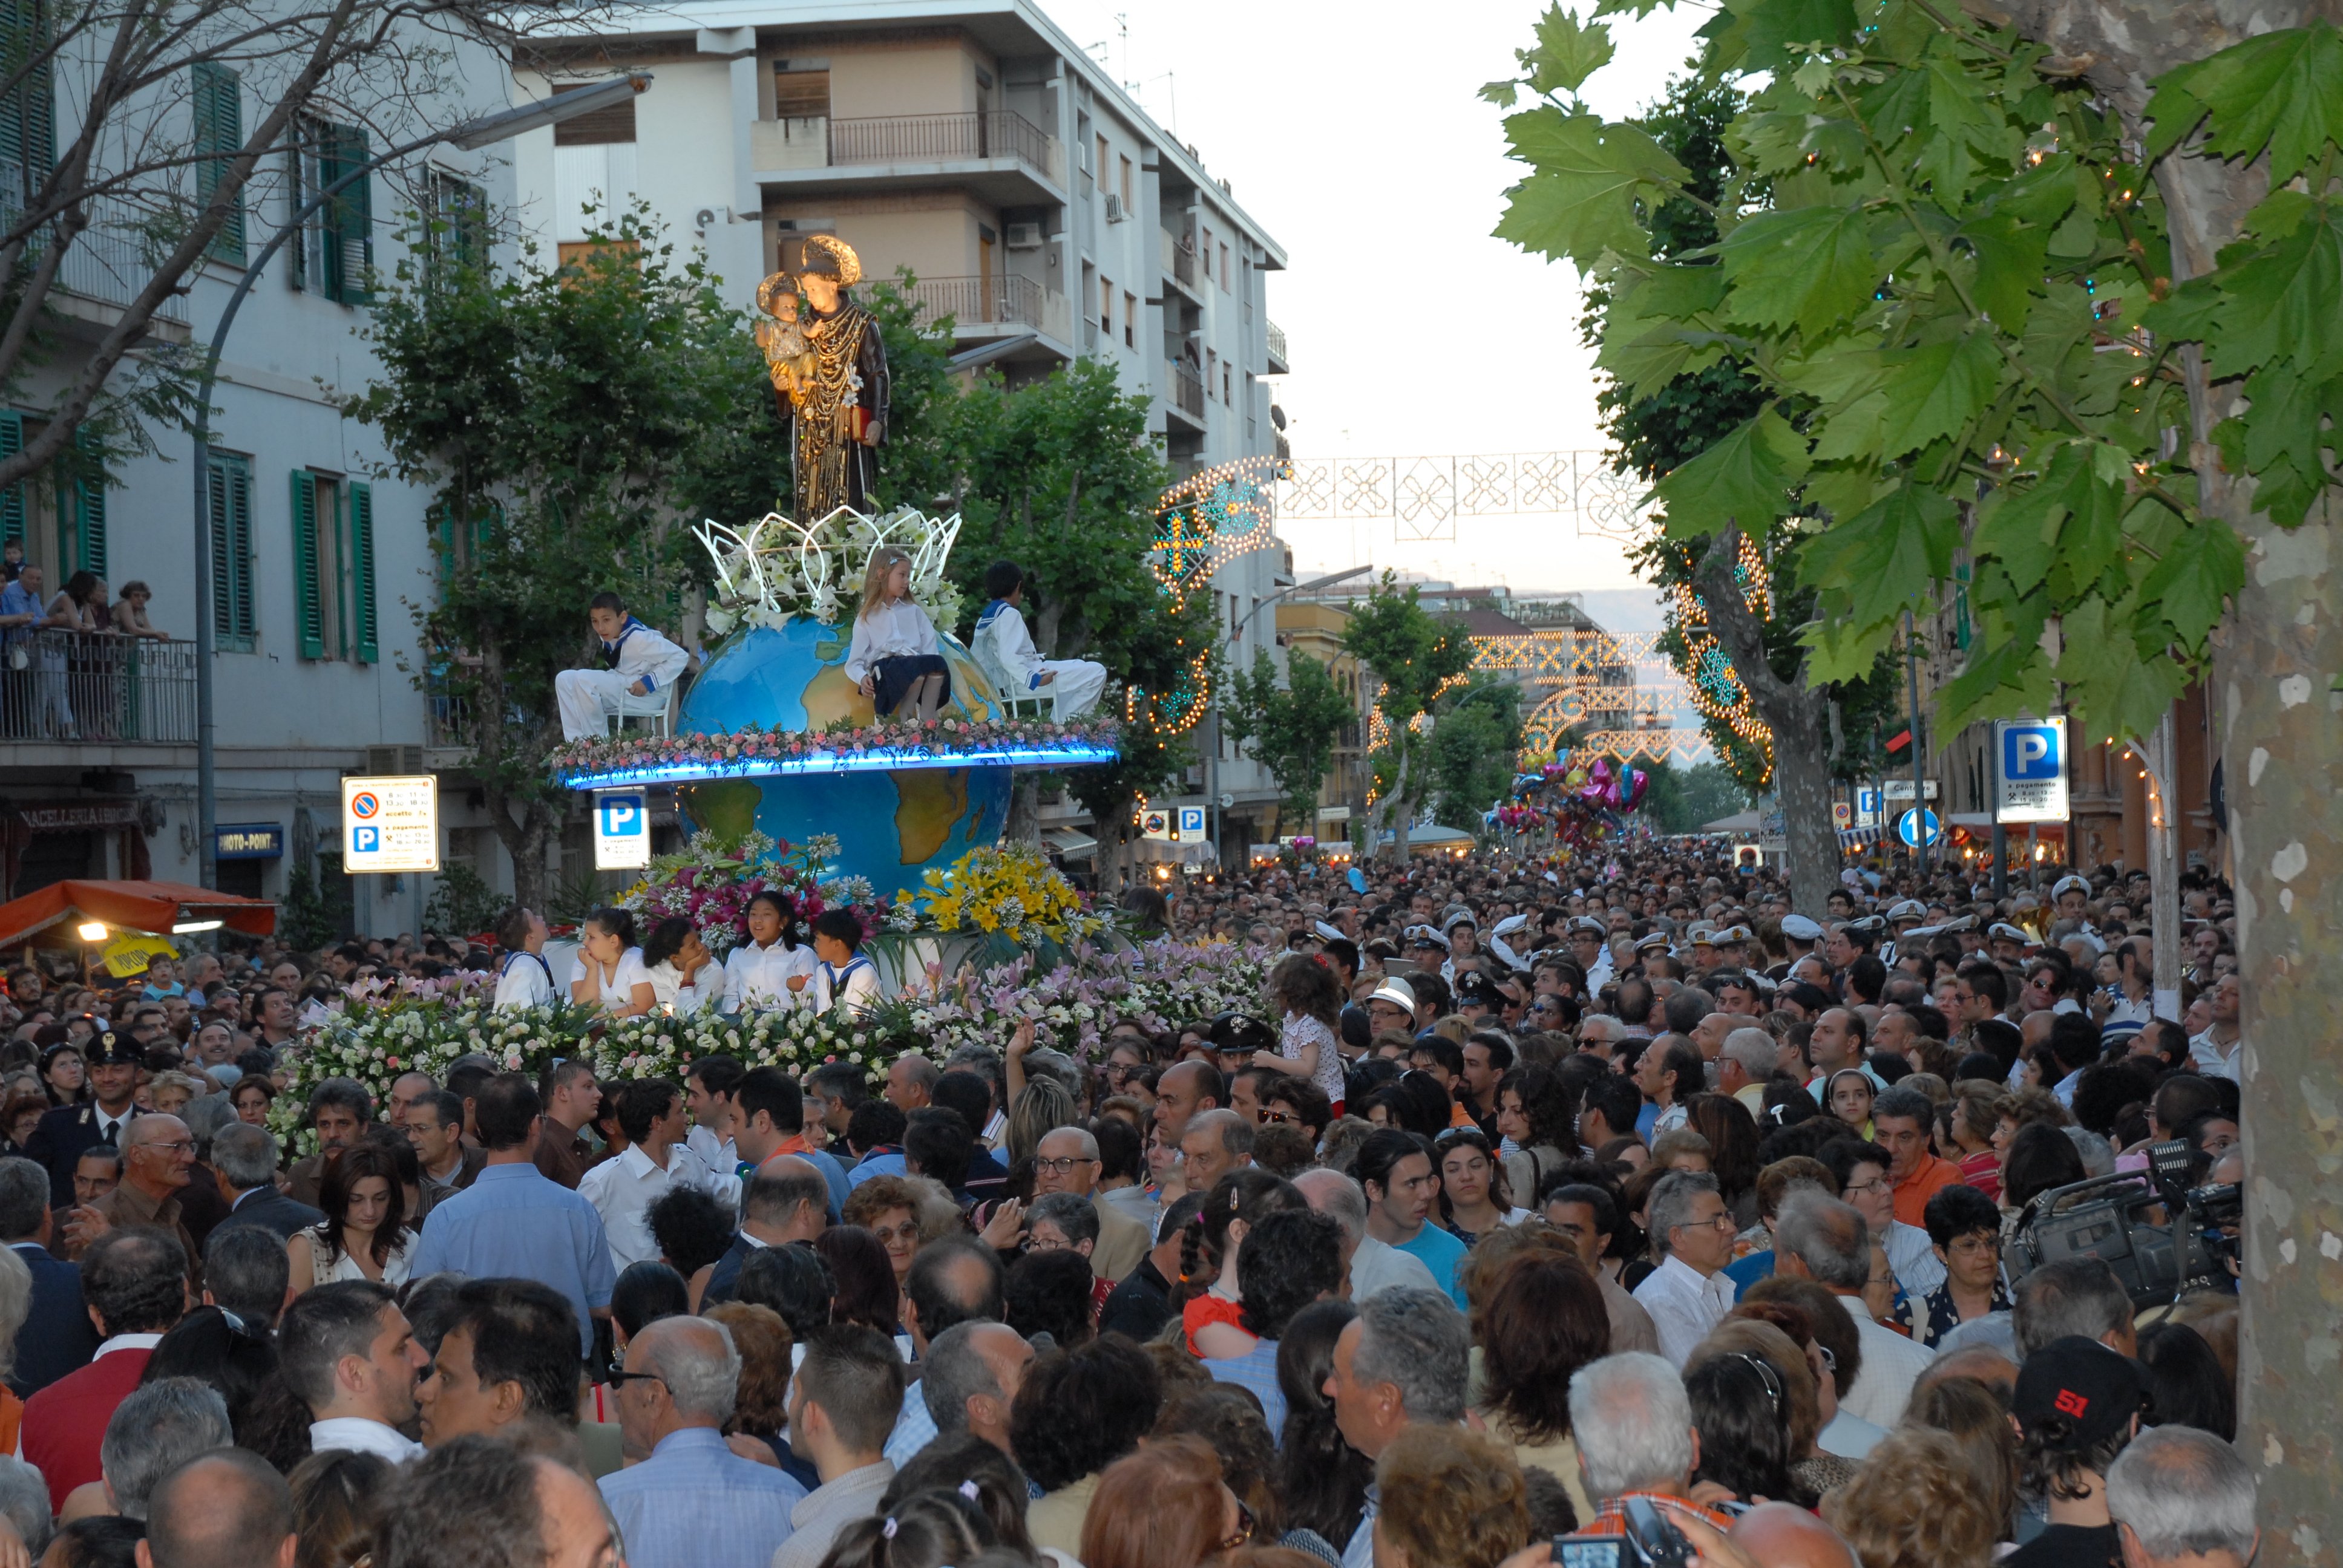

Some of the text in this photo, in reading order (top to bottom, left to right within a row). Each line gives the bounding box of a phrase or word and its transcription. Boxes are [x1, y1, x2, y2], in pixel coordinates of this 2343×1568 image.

[2016, 734, 2048, 774] P
[610, 801, 634, 833] P
[1185, 812, 1199, 828] P
[219, 833, 271, 851] PHOTO-POINT
[358, 829, 375, 851] P
[114, 947, 151, 971] POPCORN
[2054, 1388, 2089, 1419] 51
